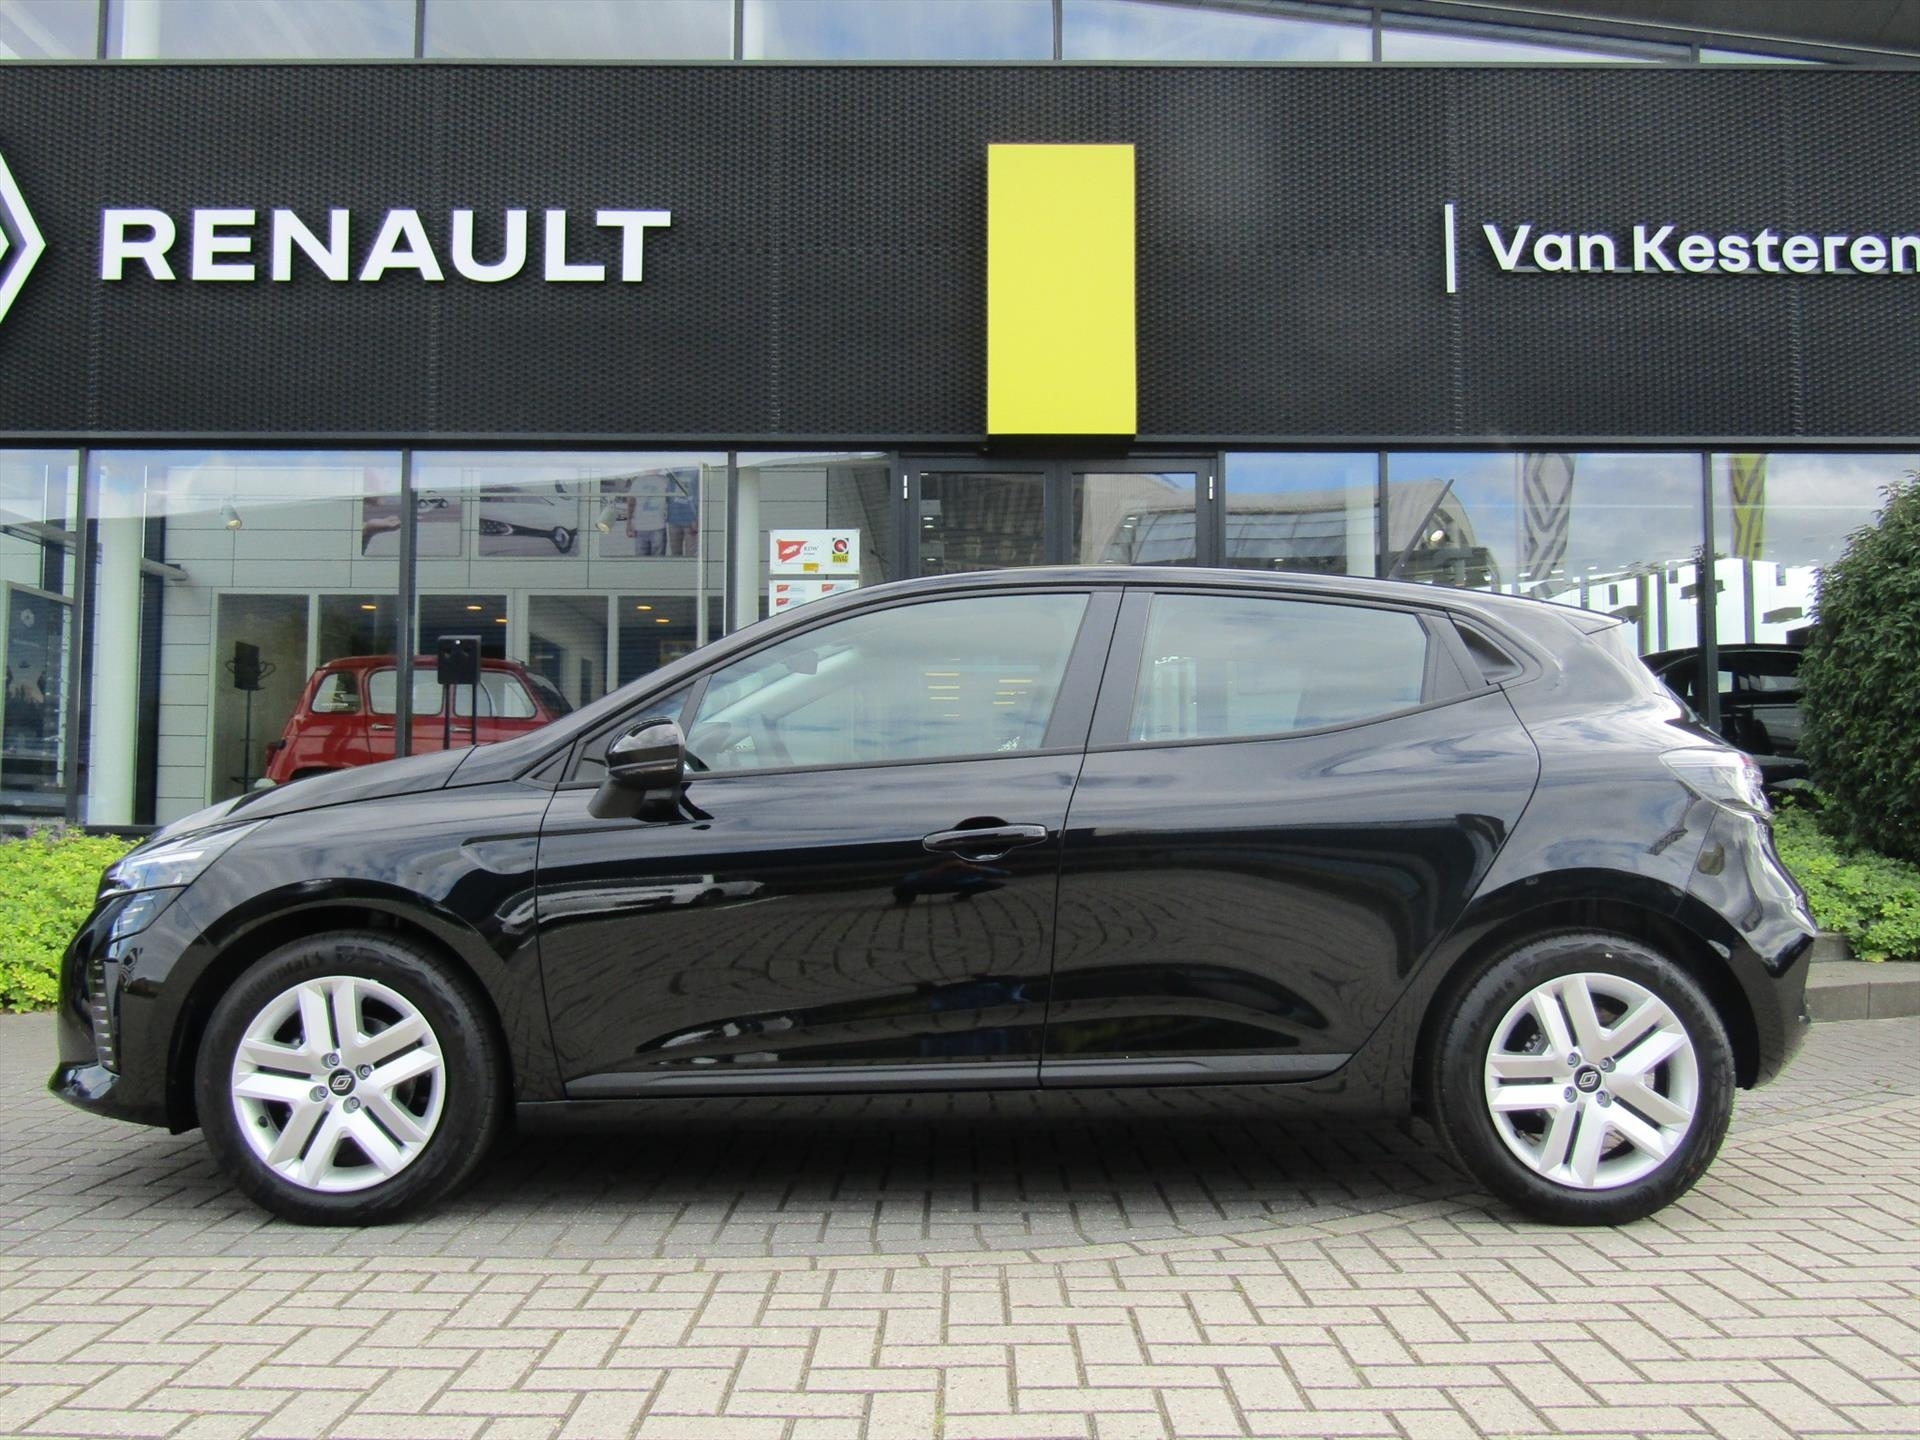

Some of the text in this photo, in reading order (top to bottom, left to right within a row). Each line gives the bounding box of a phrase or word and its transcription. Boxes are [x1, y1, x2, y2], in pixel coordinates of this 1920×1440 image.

[100, 208, 672, 283] RENAULT
[1482, 224, 1920, 274] Van Kesteren
